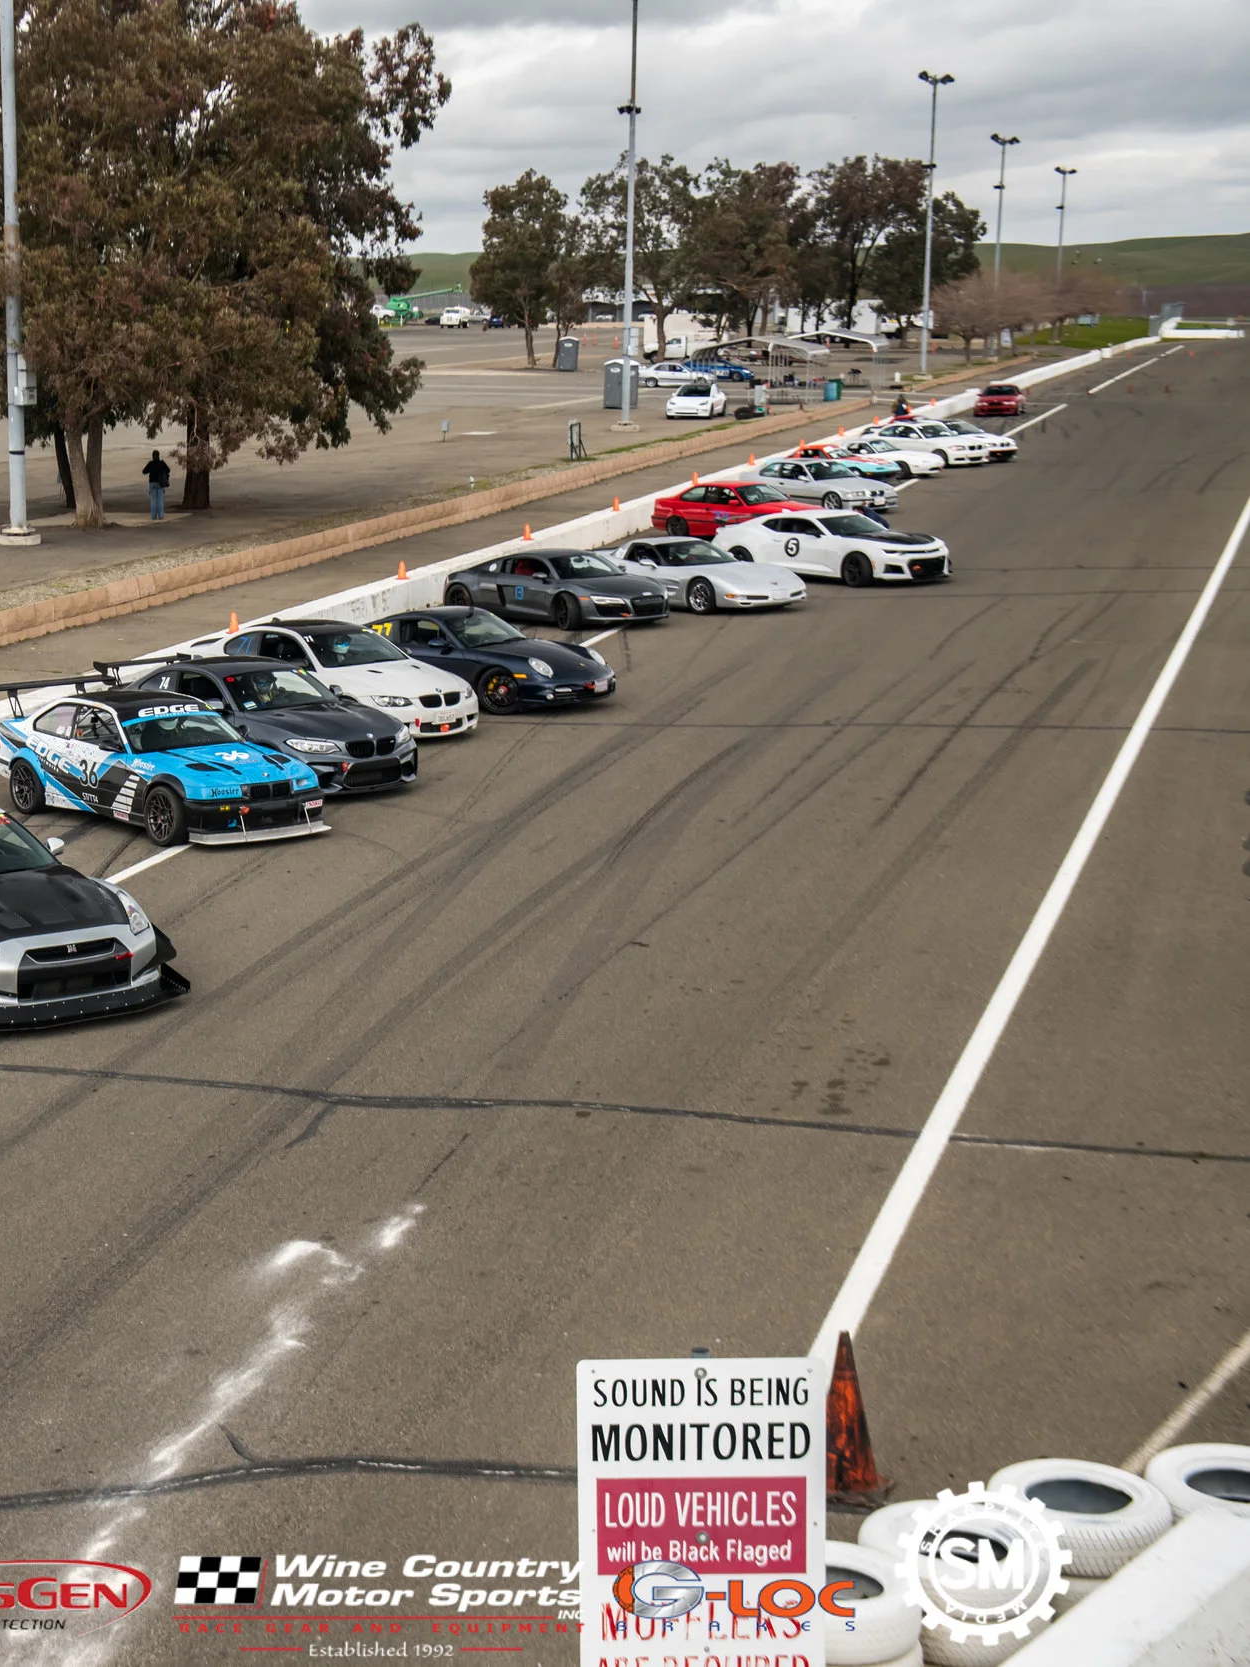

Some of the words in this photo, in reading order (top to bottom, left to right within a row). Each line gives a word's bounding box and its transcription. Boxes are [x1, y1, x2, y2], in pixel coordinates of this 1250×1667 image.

[786, 538, 799, 556] 5
[371, 622, 393, 637] 77
[138, 704, 199, 718] EDGE
[25, 733, 72, 774] EDGE
[79, 759, 99, 789] 36
[593, 1378, 686, 1407] SOUND
[697, 1377, 718, 1407] IS
[730, 1377, 809, 1406] BEING
[591, 1422, 811, 1462] MONITORED
[604, 1491, 666, 1528] LOUD
[674, 1490, 798, 1527] VEHICLES
[607, 1541, 636, 1562] will
[641, 1540, 663, 1561] be
[668, 1539, 720, 1562] Black
[726, 1538, 793, 1565] Flaged
